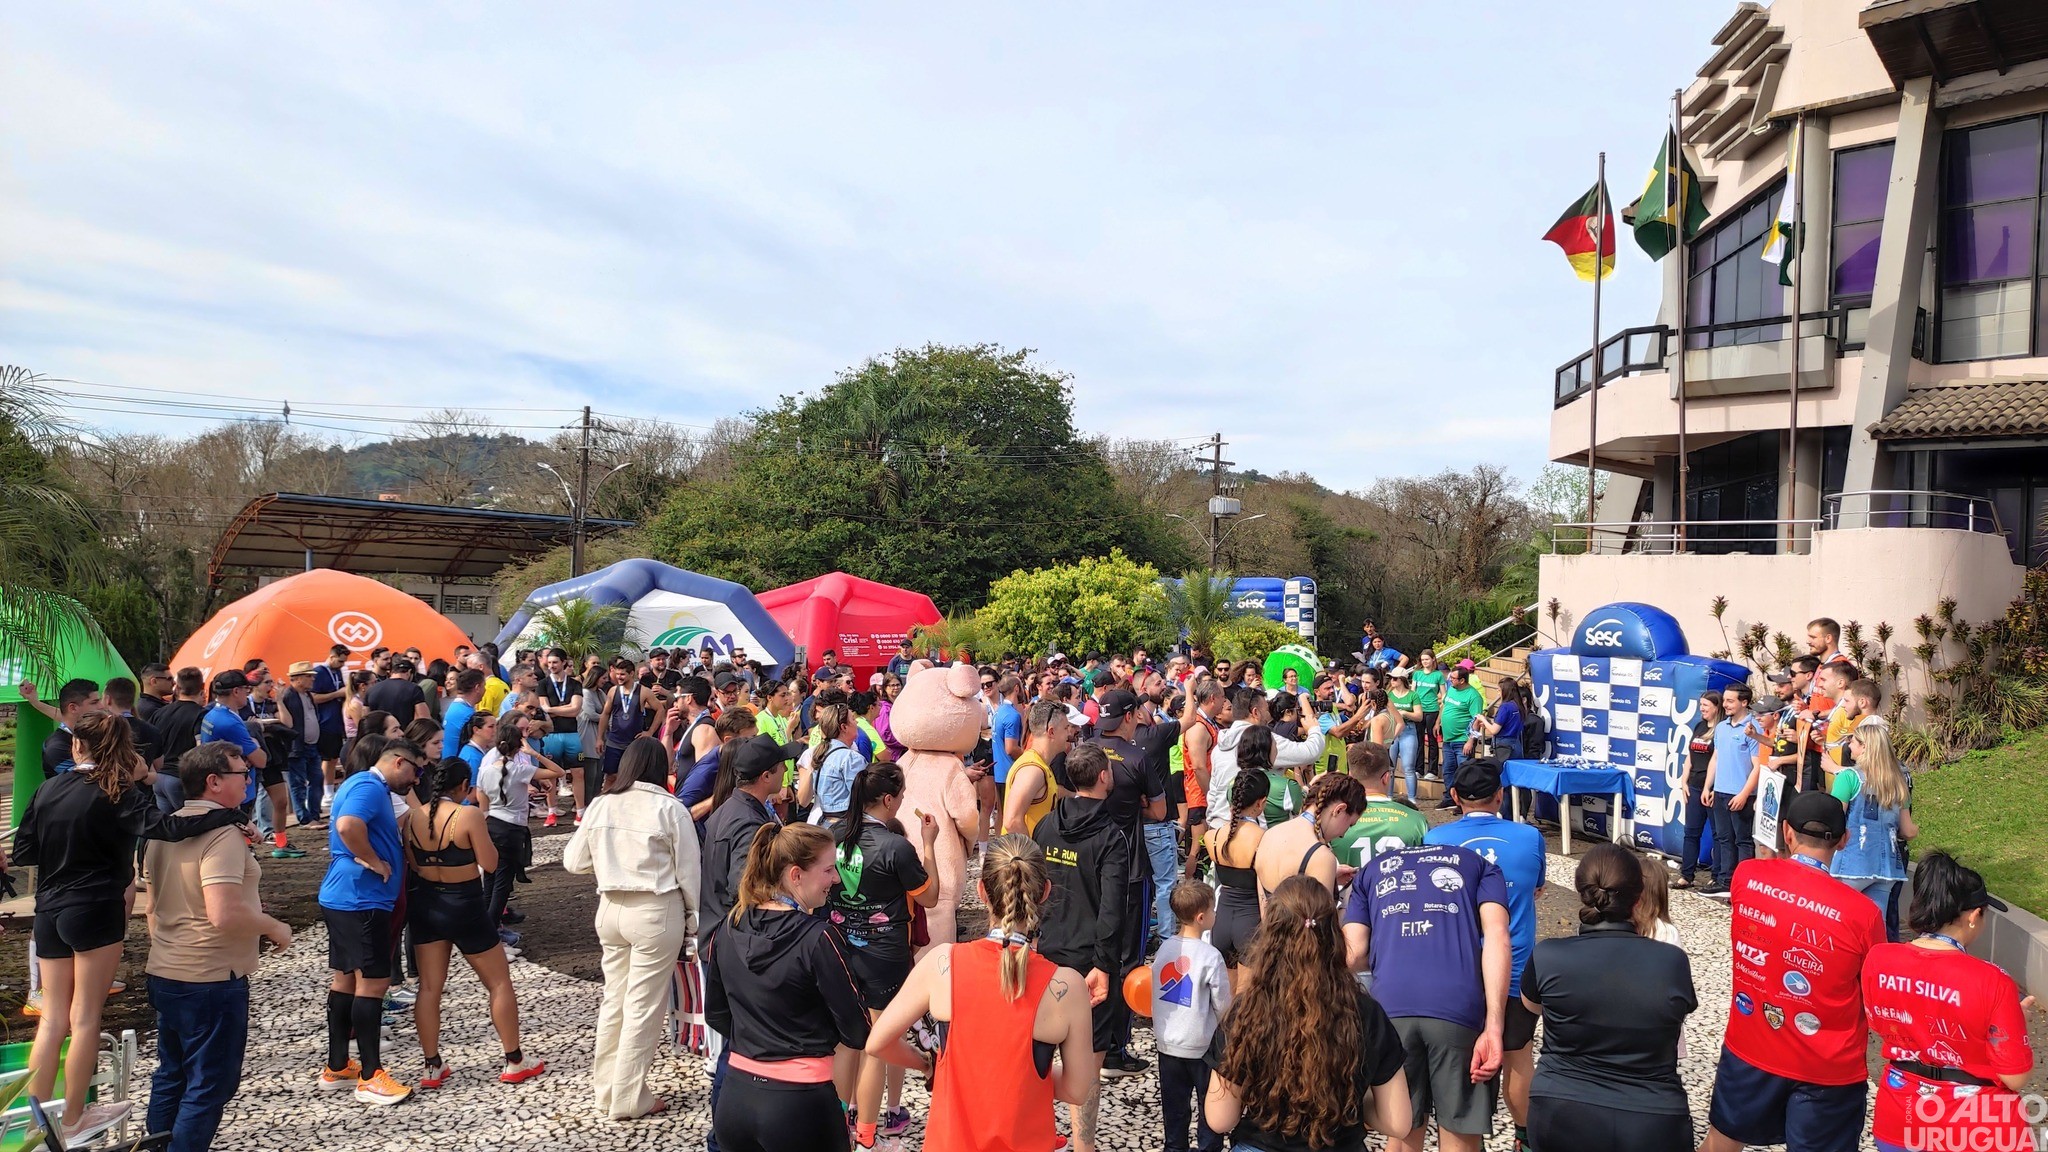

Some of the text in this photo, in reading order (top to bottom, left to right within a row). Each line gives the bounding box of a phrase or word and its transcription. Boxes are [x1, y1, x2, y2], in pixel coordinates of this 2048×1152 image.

[1585, 625, 1623, 647] Sesc
[699, 634, 735, 657] A1
[1582, 666, 1599, 676] Sesc
[1643, 670, 1662, 681] Sesc
[1582, 692, 1597, 702] Sesc
[1640, 698, 1658, 708] Sesc
[1582, 717, 1597, 728] Sesc
[1638, 723, 1655, 735] Sesc
[1582, 744, 1596, 753] Sesc
[1637, 752, 1653, 762] Sesc
[1636, 778, 1652, 790] Sesc
[1378, 808, 1408, 817] VETERANOS
[1636, 806, 1650, 818] Sesc
[1637, 833, 1654, 845] Sesc
[1062, 849, 1078, 862] RUN
[1747, 879, 1842, 922] MARCOS DANIEL
[1736, 940, 1770, 963] MTX
[1782, 950, 1824, 973] OLIVEIRA
[1879, 974, 1961, 1007] PATI SILVA
[1926, 1016, 1967, 1039] AVA
